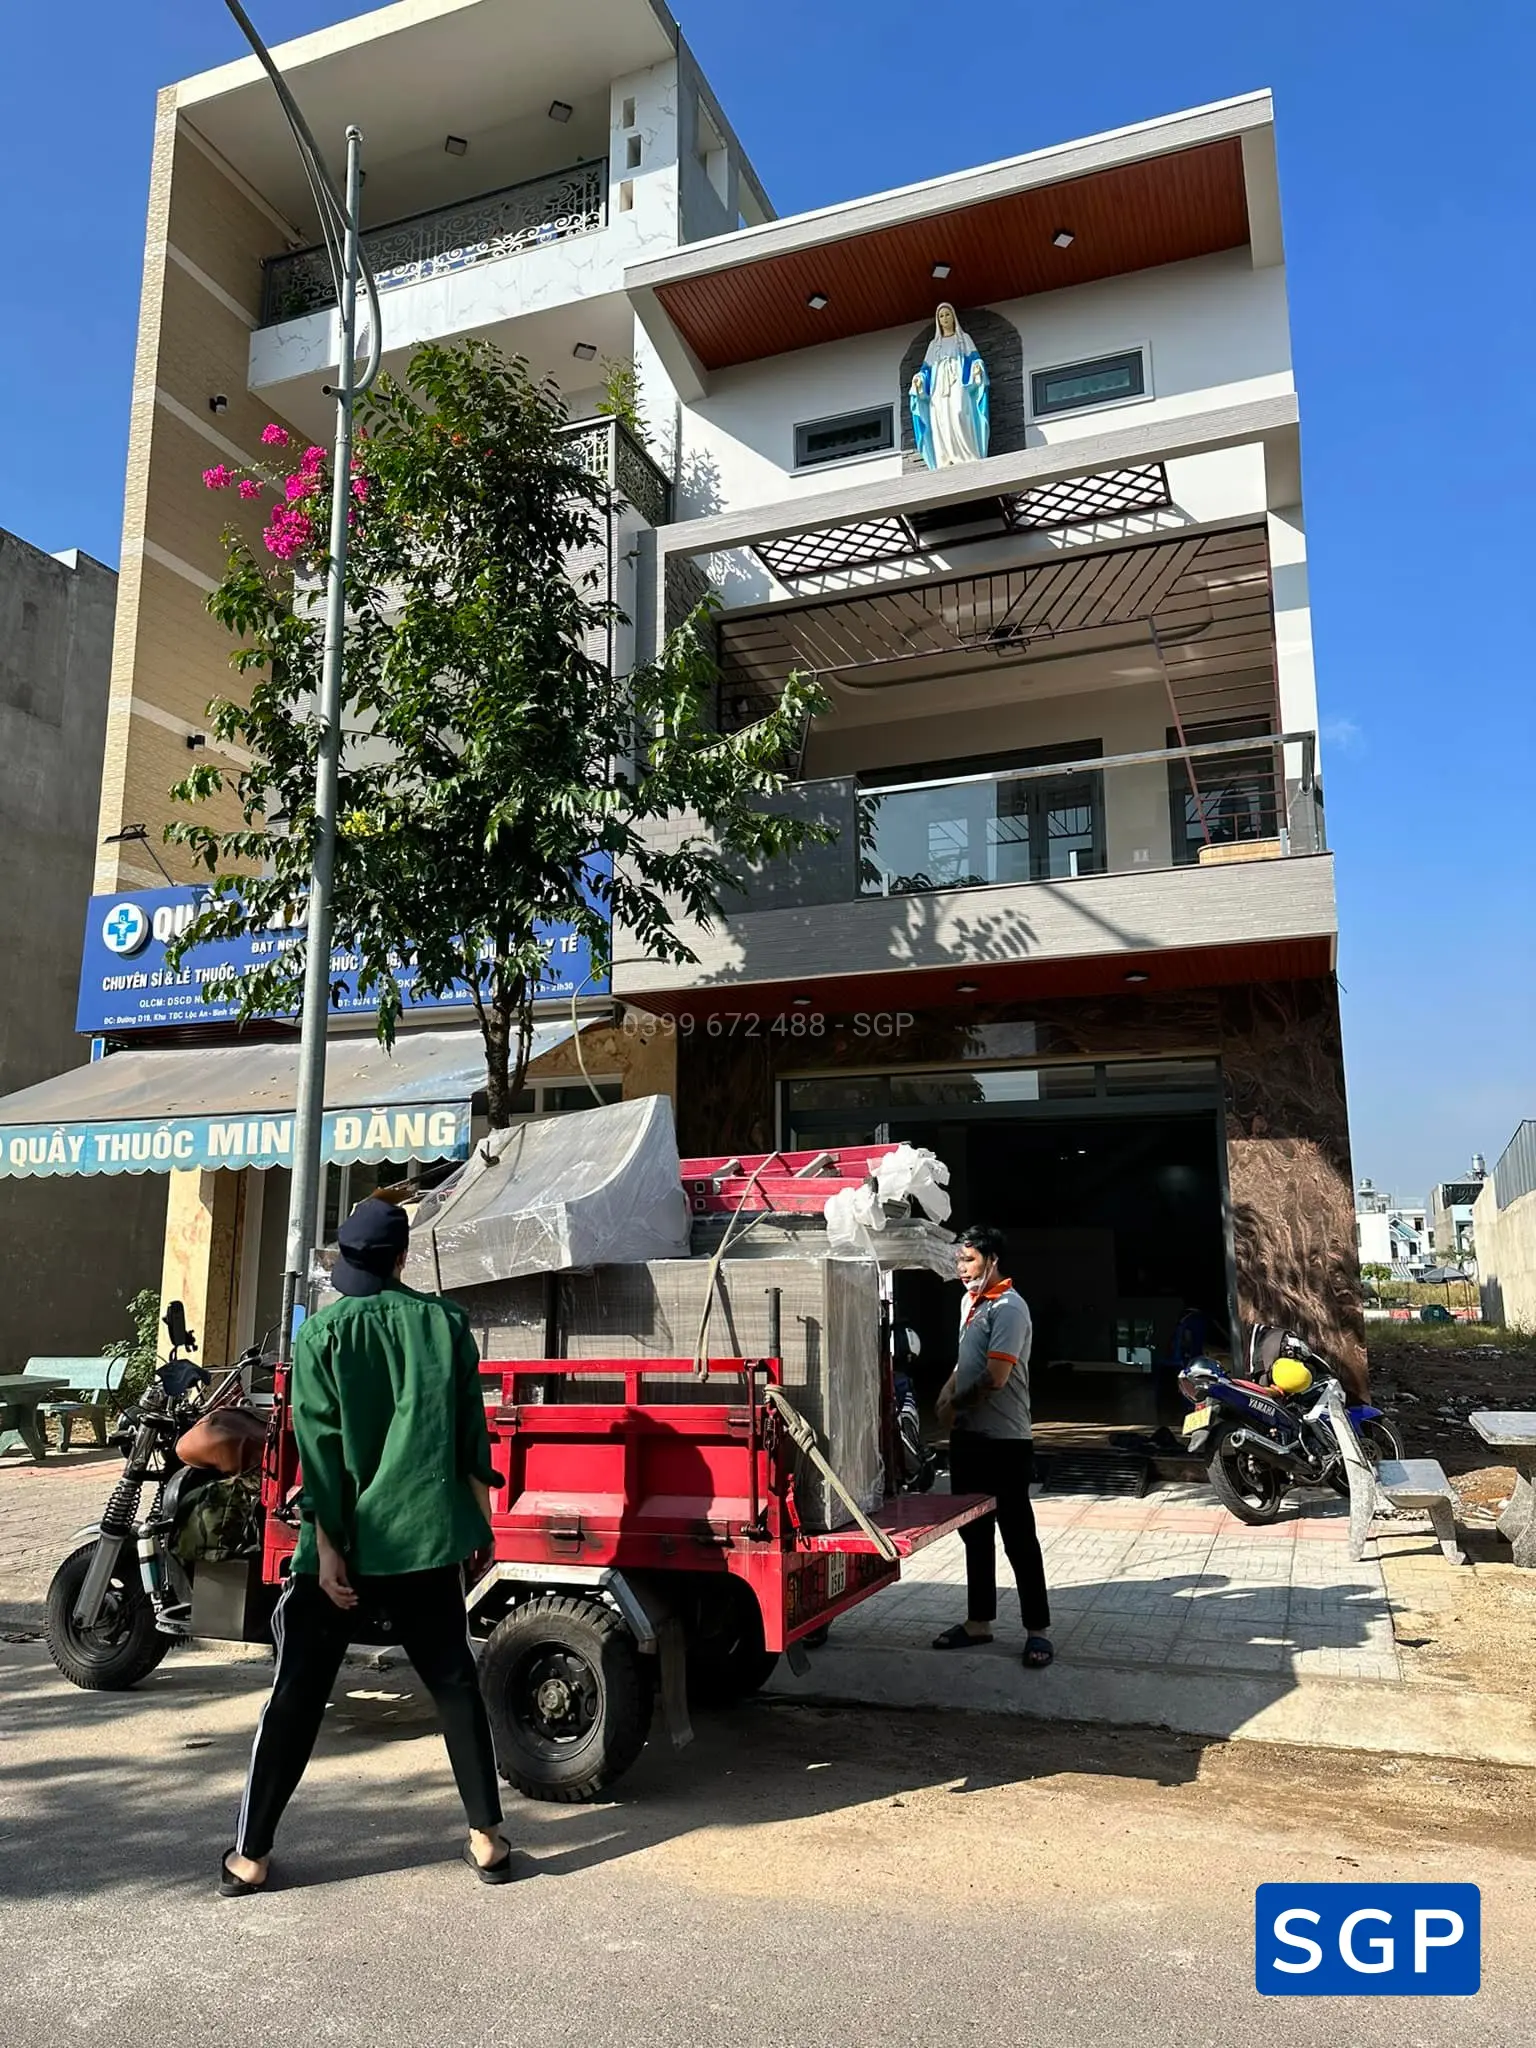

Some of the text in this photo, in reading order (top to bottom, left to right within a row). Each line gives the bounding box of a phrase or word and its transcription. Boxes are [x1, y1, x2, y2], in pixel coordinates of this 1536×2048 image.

[251, 941, 275, 955] ĐẠT
[102, 971, 148, 991] CHUYÊN
[164, 970, 174, 986] &
[329, 951, 358, 971] HỨC
[139, 998, 165, 1009] QLCM:
[153, 1011, 167, 1021] Khu
[9, 1126, 85, 1168] QUẦY
[94, 1121, 194, 1162] THUỐC
[207, 1119, 300, 1158] MIN
[1248, 1398, 1276, 1417] YAMAHA
